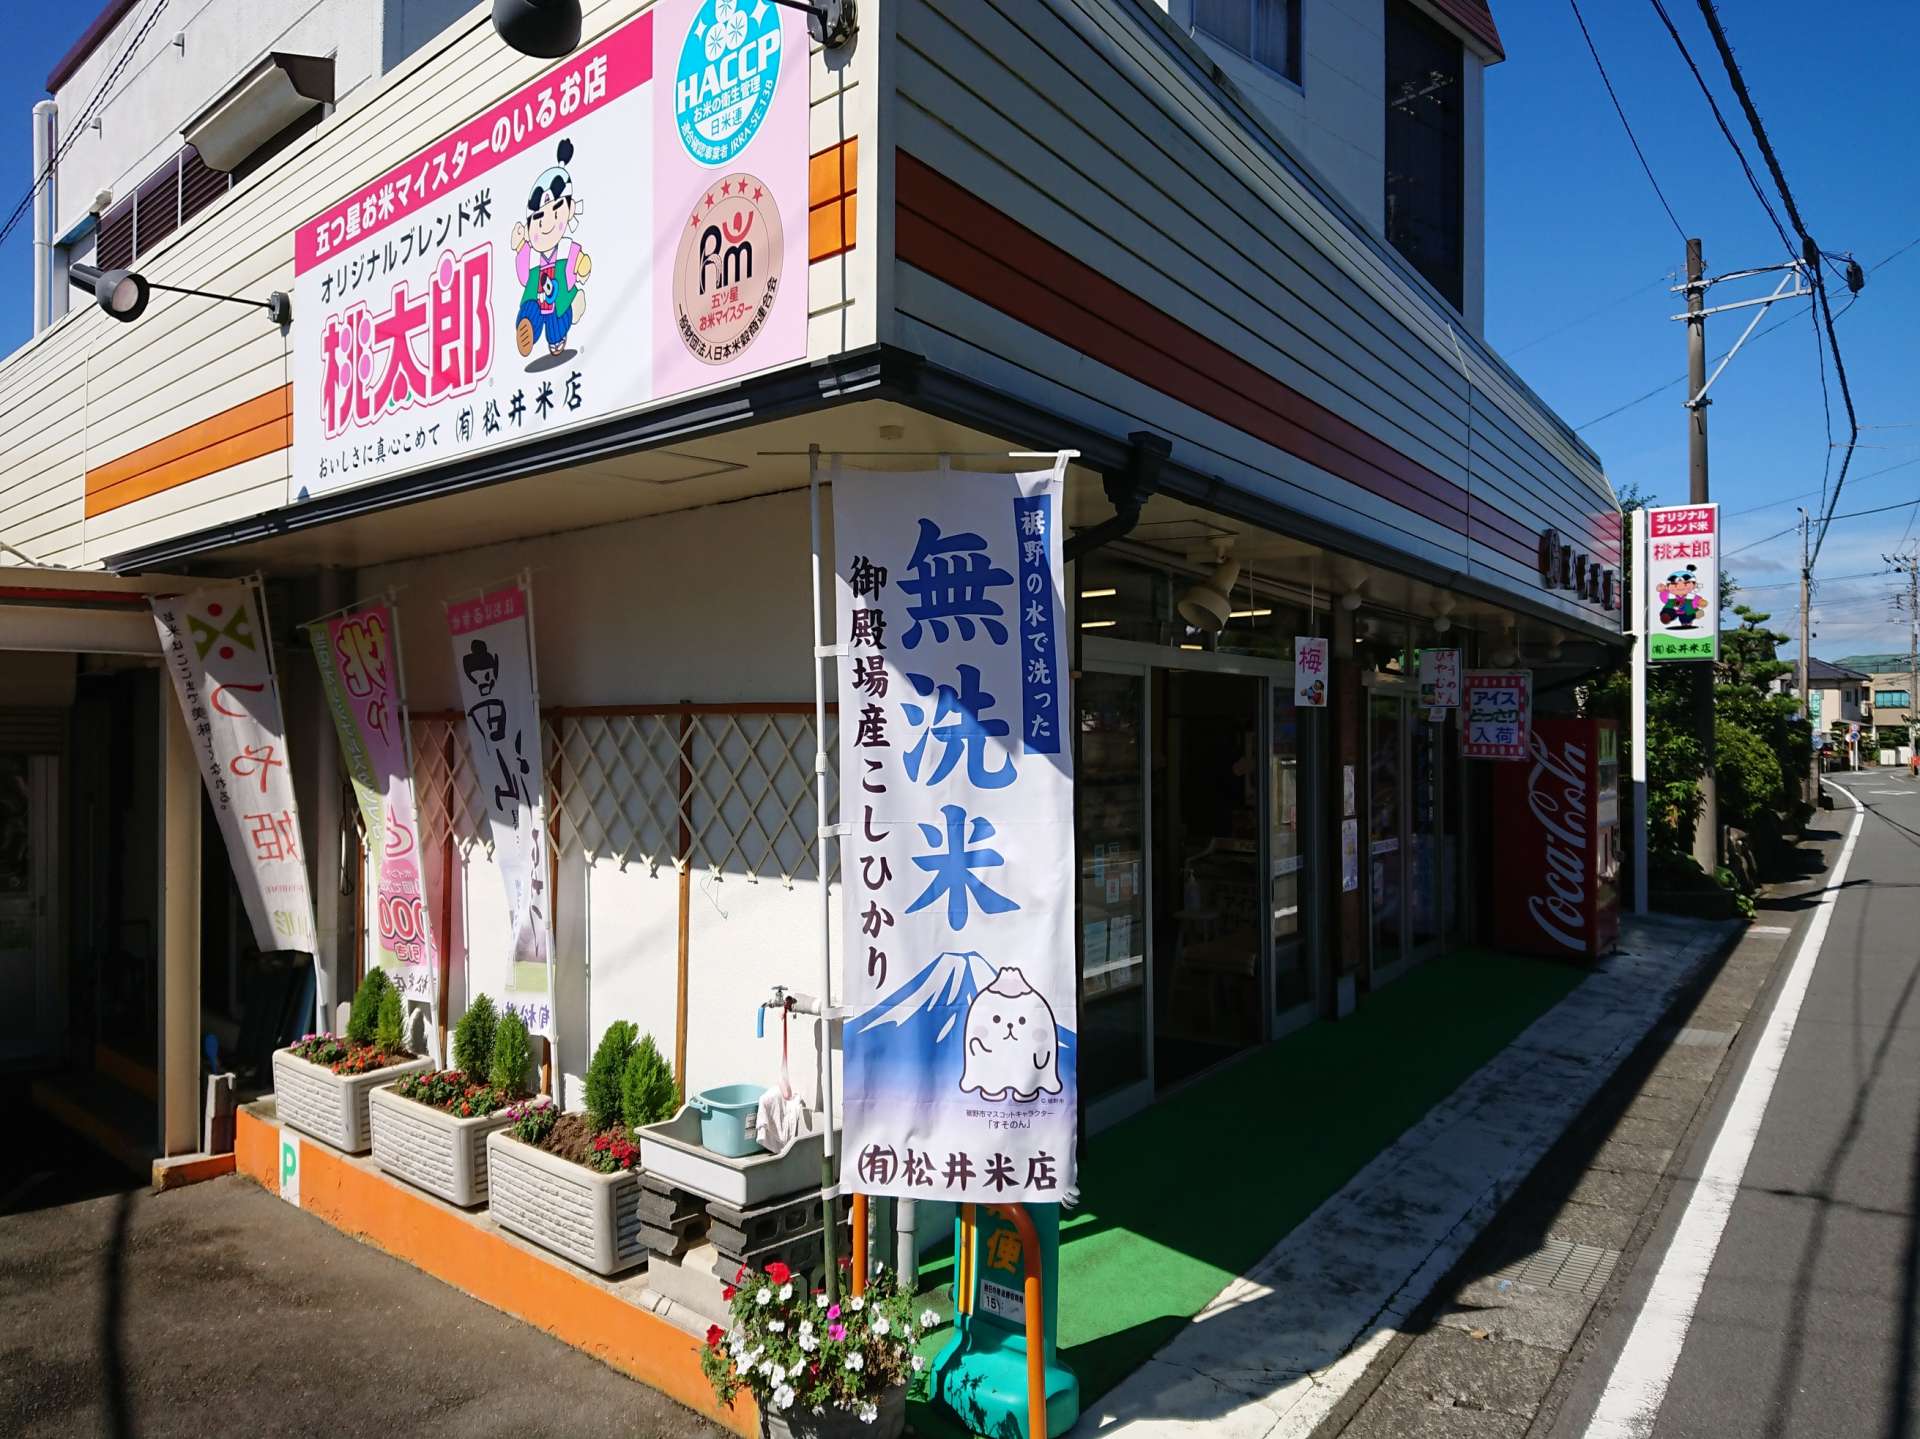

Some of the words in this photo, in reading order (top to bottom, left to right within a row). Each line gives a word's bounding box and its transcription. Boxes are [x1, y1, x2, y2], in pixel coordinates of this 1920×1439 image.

[677, 28, 780, 114] HACCP
[693, 75, 761, 122] お米の衛生管理
[711, 106, 743, 136] 日米連
[315, 54, 608, 257] 五つ星お米マイスターのいるお店
[321, 187, 492, 304] オリジナルブレンド米
[699, 302, 753, 332] お米マイスター
[711, 286, 739, 309] 五ツ星
[321, 242, 495, 440] 桃太郎
[319, 423, 441, 479] おいしさに真心こめて
[455, 371, 583, 443] (有)松井米店
[1656, 510, 1708, 522] オリジナル
[1656, 522, 1708, 535] ブレンド米
[1653, 541, 1712, 561] 桃太郎
[1020, 509, 1052, 738] 裾野の水で洗った
[1299, 649, 1322, 675] 梅
[1468, 709, 1519, 723] どっさり
[1473, 690, 1517, 706] アイス
[896, 517, 1021, 931] 無洗米
[1474, 727, 1515, 743] 入荷
[849, 555, 893, 989] 御殿場産こしひかり
[1528, 729, 1587, 951] Coca-Cola
[282, 1142, 297, 1188] P
[857, 1143, 1058, 1192] (有)松井米店
